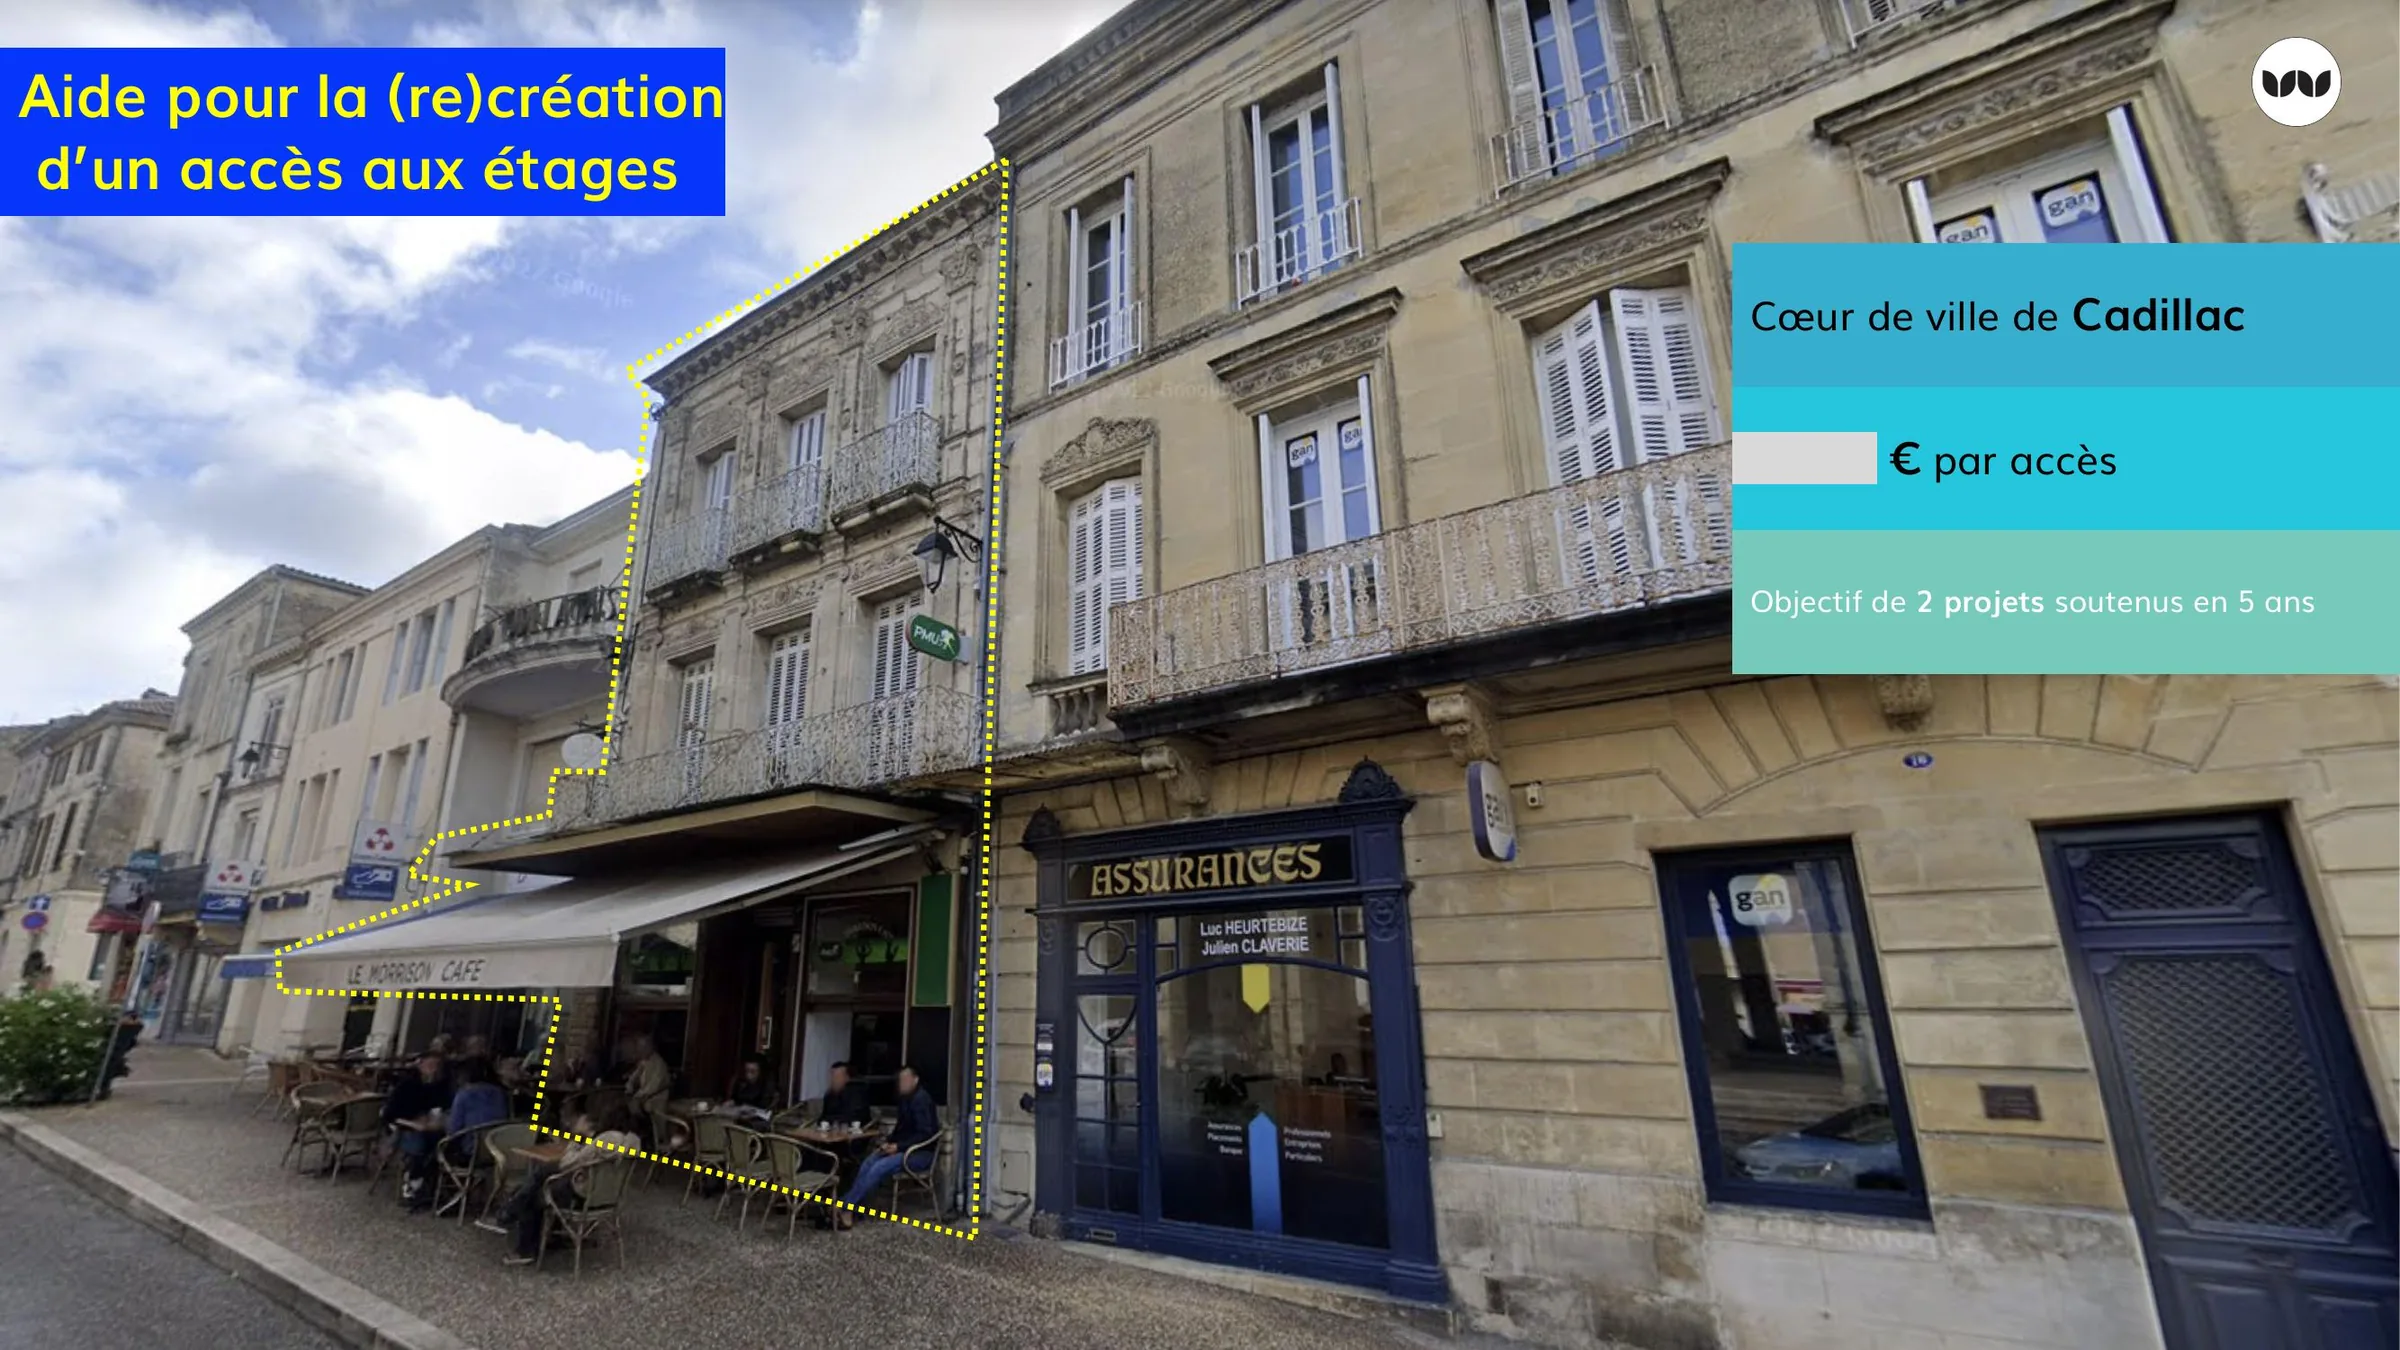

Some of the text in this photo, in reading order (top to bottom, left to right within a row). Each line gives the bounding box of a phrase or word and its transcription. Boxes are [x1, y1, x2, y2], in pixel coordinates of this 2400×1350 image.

[2047, 190, 2094, 218] gan
[1290, 443, 1314, 462] gan
[913, 624, 940, 645] PMU
[1090, 843, 1322, 897] ASSURANCES
[1735, 887, 1785, 911] gan
[1200, 916, 1308, 936] Luc HEURTEBIZE
[1202, 936, 1309, 956] Julien CLAVERIE
[348, 964, 363, 985] LE
[368, 961, 435, 984] MORRISON
